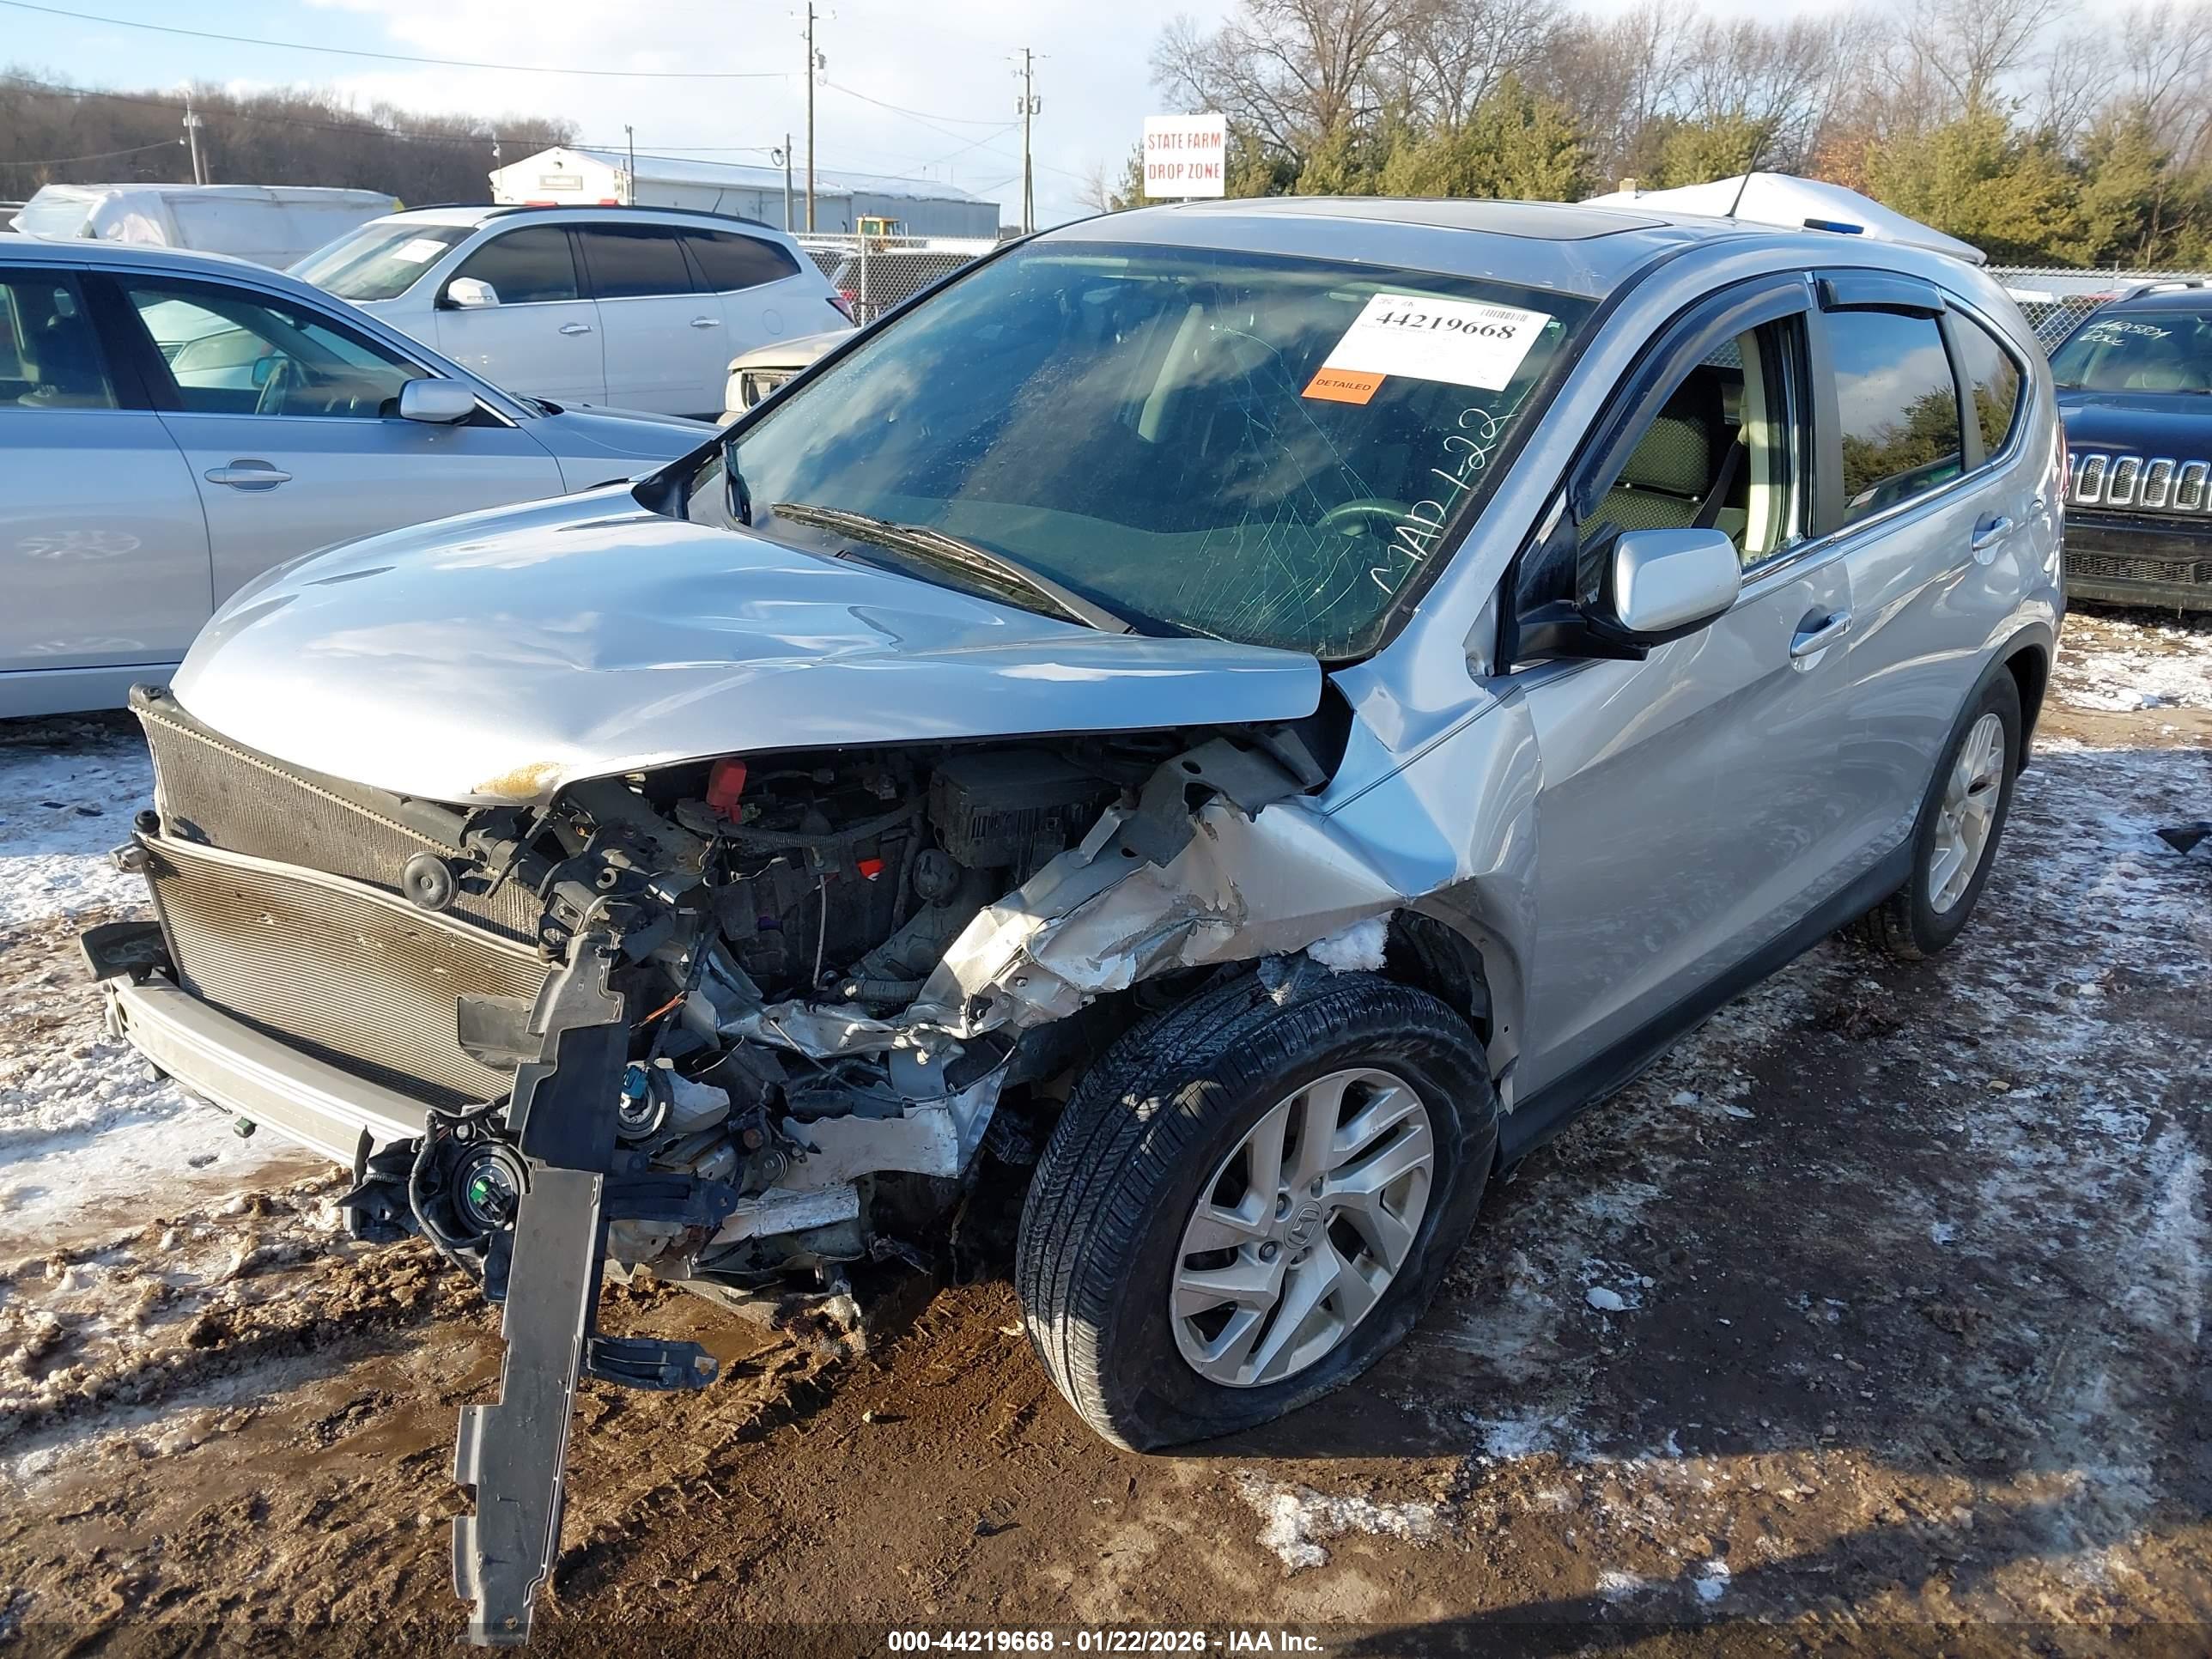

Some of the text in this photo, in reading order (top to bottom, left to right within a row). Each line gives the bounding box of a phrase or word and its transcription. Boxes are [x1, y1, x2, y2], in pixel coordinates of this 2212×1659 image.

[1148, 132, 1221, 149] STATE FARM
[1149, 163, 1220, 179] DROP ZONE
[1376, 312, 1516, 340] 44219668
[1316, 379, 1371, 392] DETAILED
[1370, 500, 1447, 595] MAD
